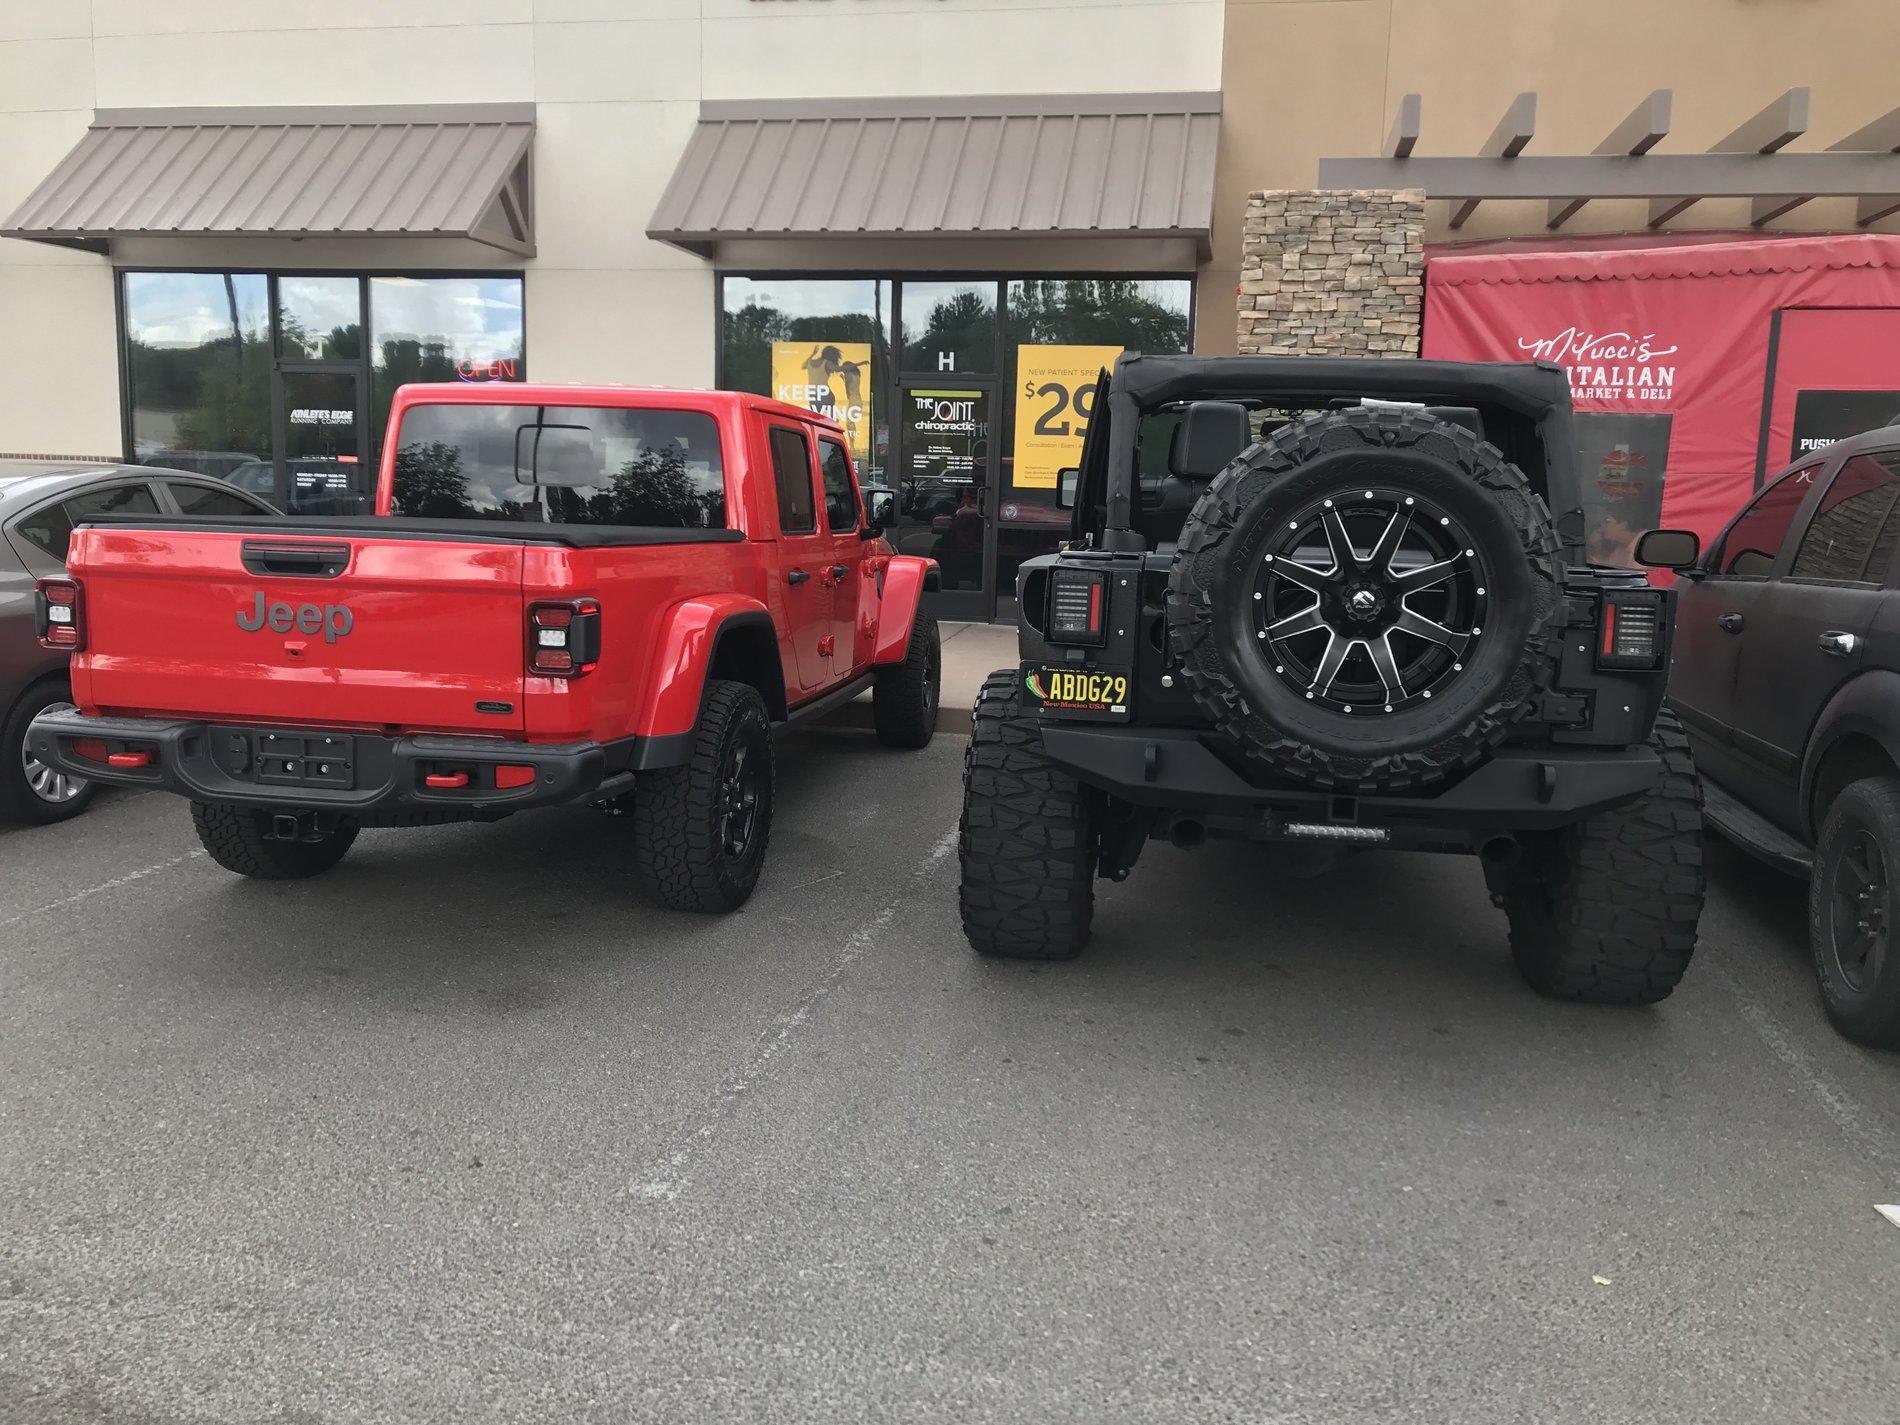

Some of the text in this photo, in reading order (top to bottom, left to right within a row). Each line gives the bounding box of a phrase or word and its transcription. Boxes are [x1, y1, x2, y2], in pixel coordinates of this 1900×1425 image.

[939, 352, 954, 371] H
[1047, 369, 1077, 377] PATIENT
[779, 384, 830, 401] KEEP
[1626, 387, 1635, 399] &
[1640, 388, 1673, 400] DELI
[915, 398, 934, 410] THE
[331, 410, 354, 420] EDGE
[915, 420, 975, 431] chiropractic
[236, 591, 353, 644] Jeep
[1050, 673, 1126, 703] ABDG29
[1043, 700, 1060, 708] New
